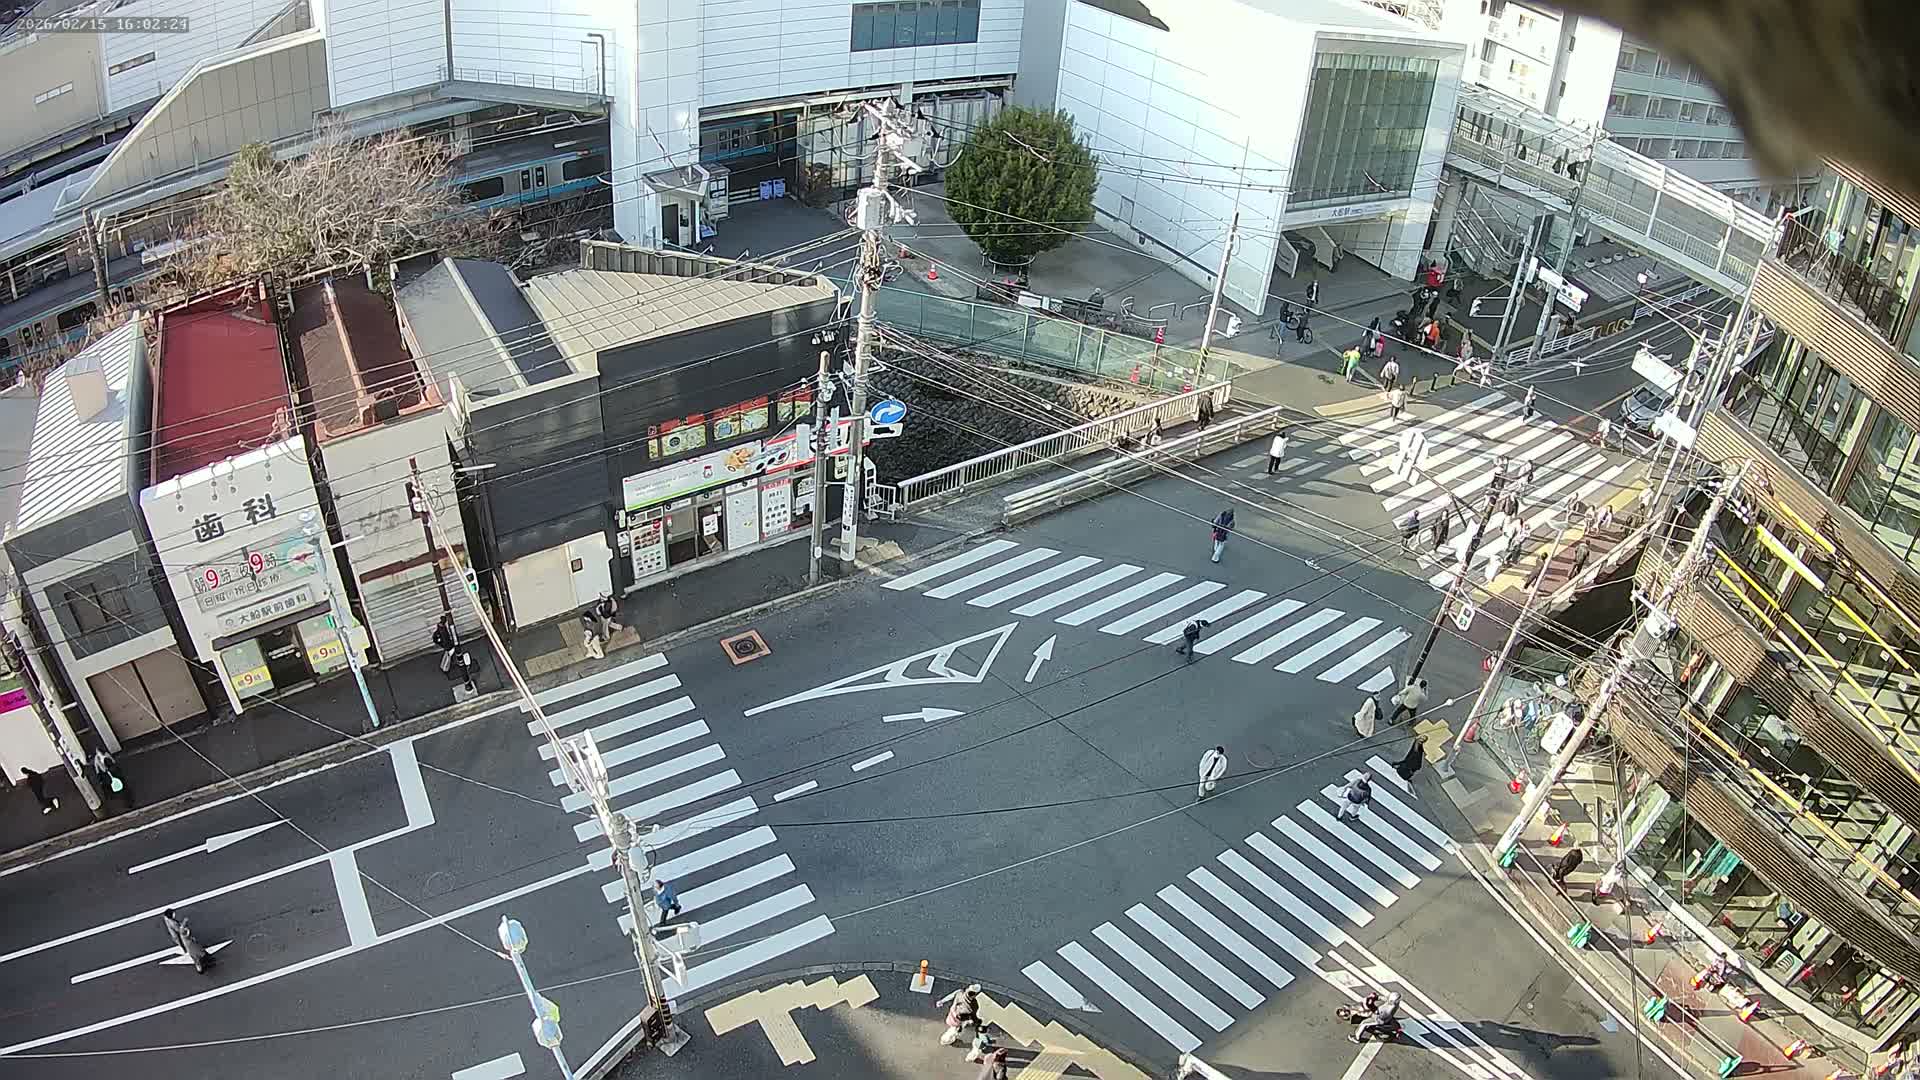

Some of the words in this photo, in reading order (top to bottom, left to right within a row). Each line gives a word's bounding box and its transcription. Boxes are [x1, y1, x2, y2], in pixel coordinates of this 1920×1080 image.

[192, 493, 277, 543] 歯科
[239, 592, 308, 625] 大船駅前歯科
